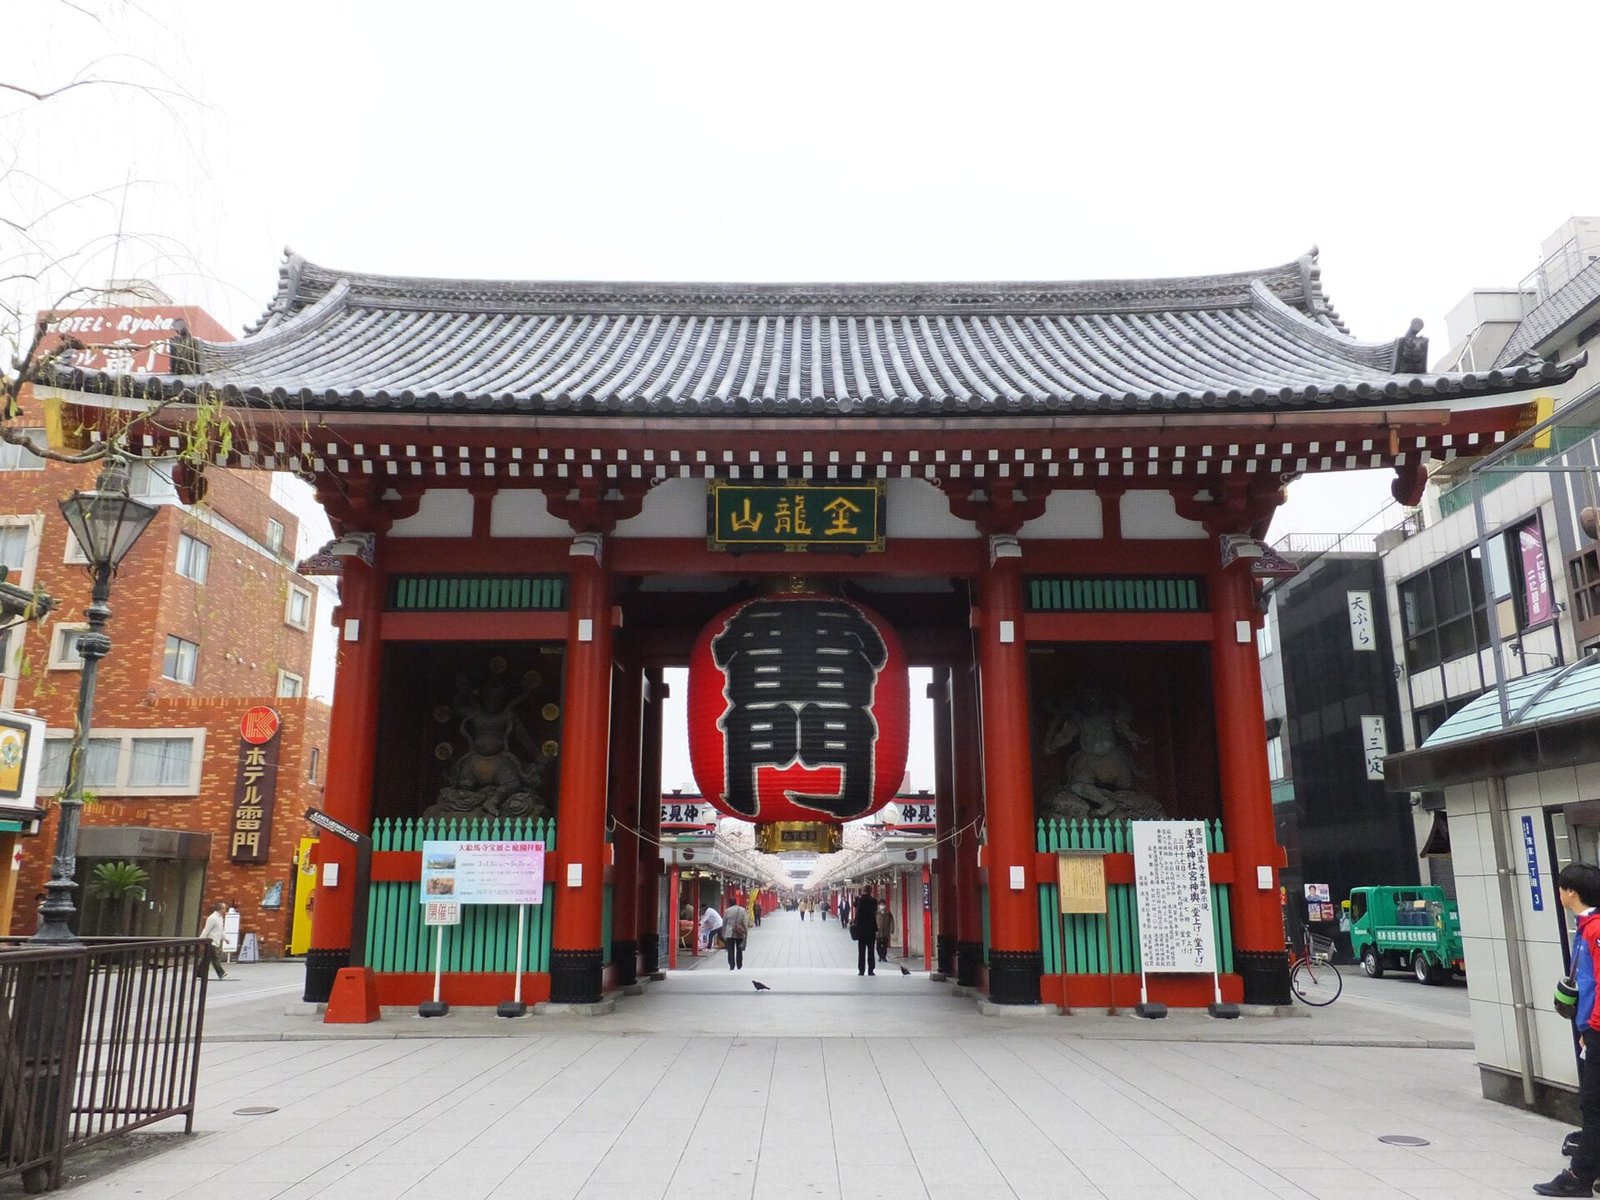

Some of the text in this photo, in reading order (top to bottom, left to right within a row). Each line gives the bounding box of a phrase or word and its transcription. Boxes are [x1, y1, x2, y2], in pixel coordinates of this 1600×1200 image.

[232, 747, 266, 857] ホテル雷門
[902, 804, 936, 823] 仲見
[1534, 893, 1540, 904] 3
